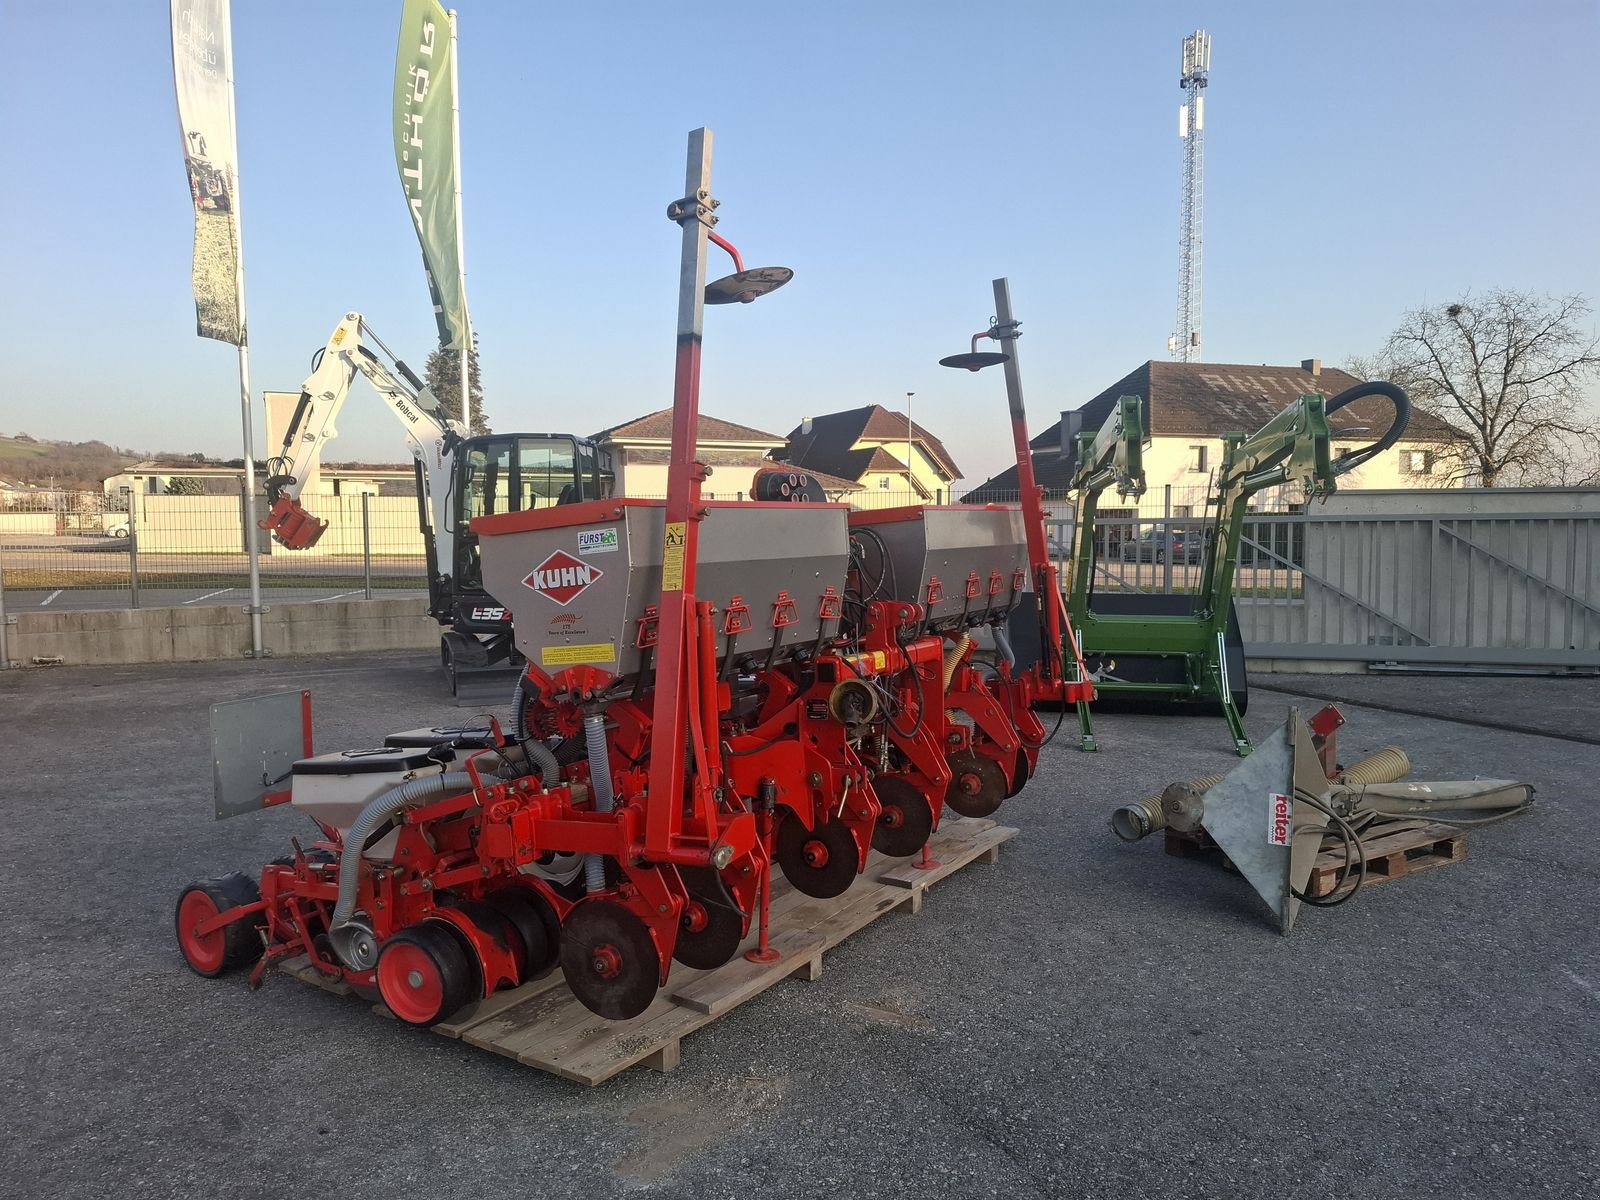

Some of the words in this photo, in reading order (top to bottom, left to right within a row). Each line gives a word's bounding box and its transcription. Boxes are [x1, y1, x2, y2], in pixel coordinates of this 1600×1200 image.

[395, 399, 419, 424] Bobcat
[579, 532, 605, 545] FÜRST
[532, 565, 591, 590] KUHN
[1275, 795, 1291, 844] reiter
